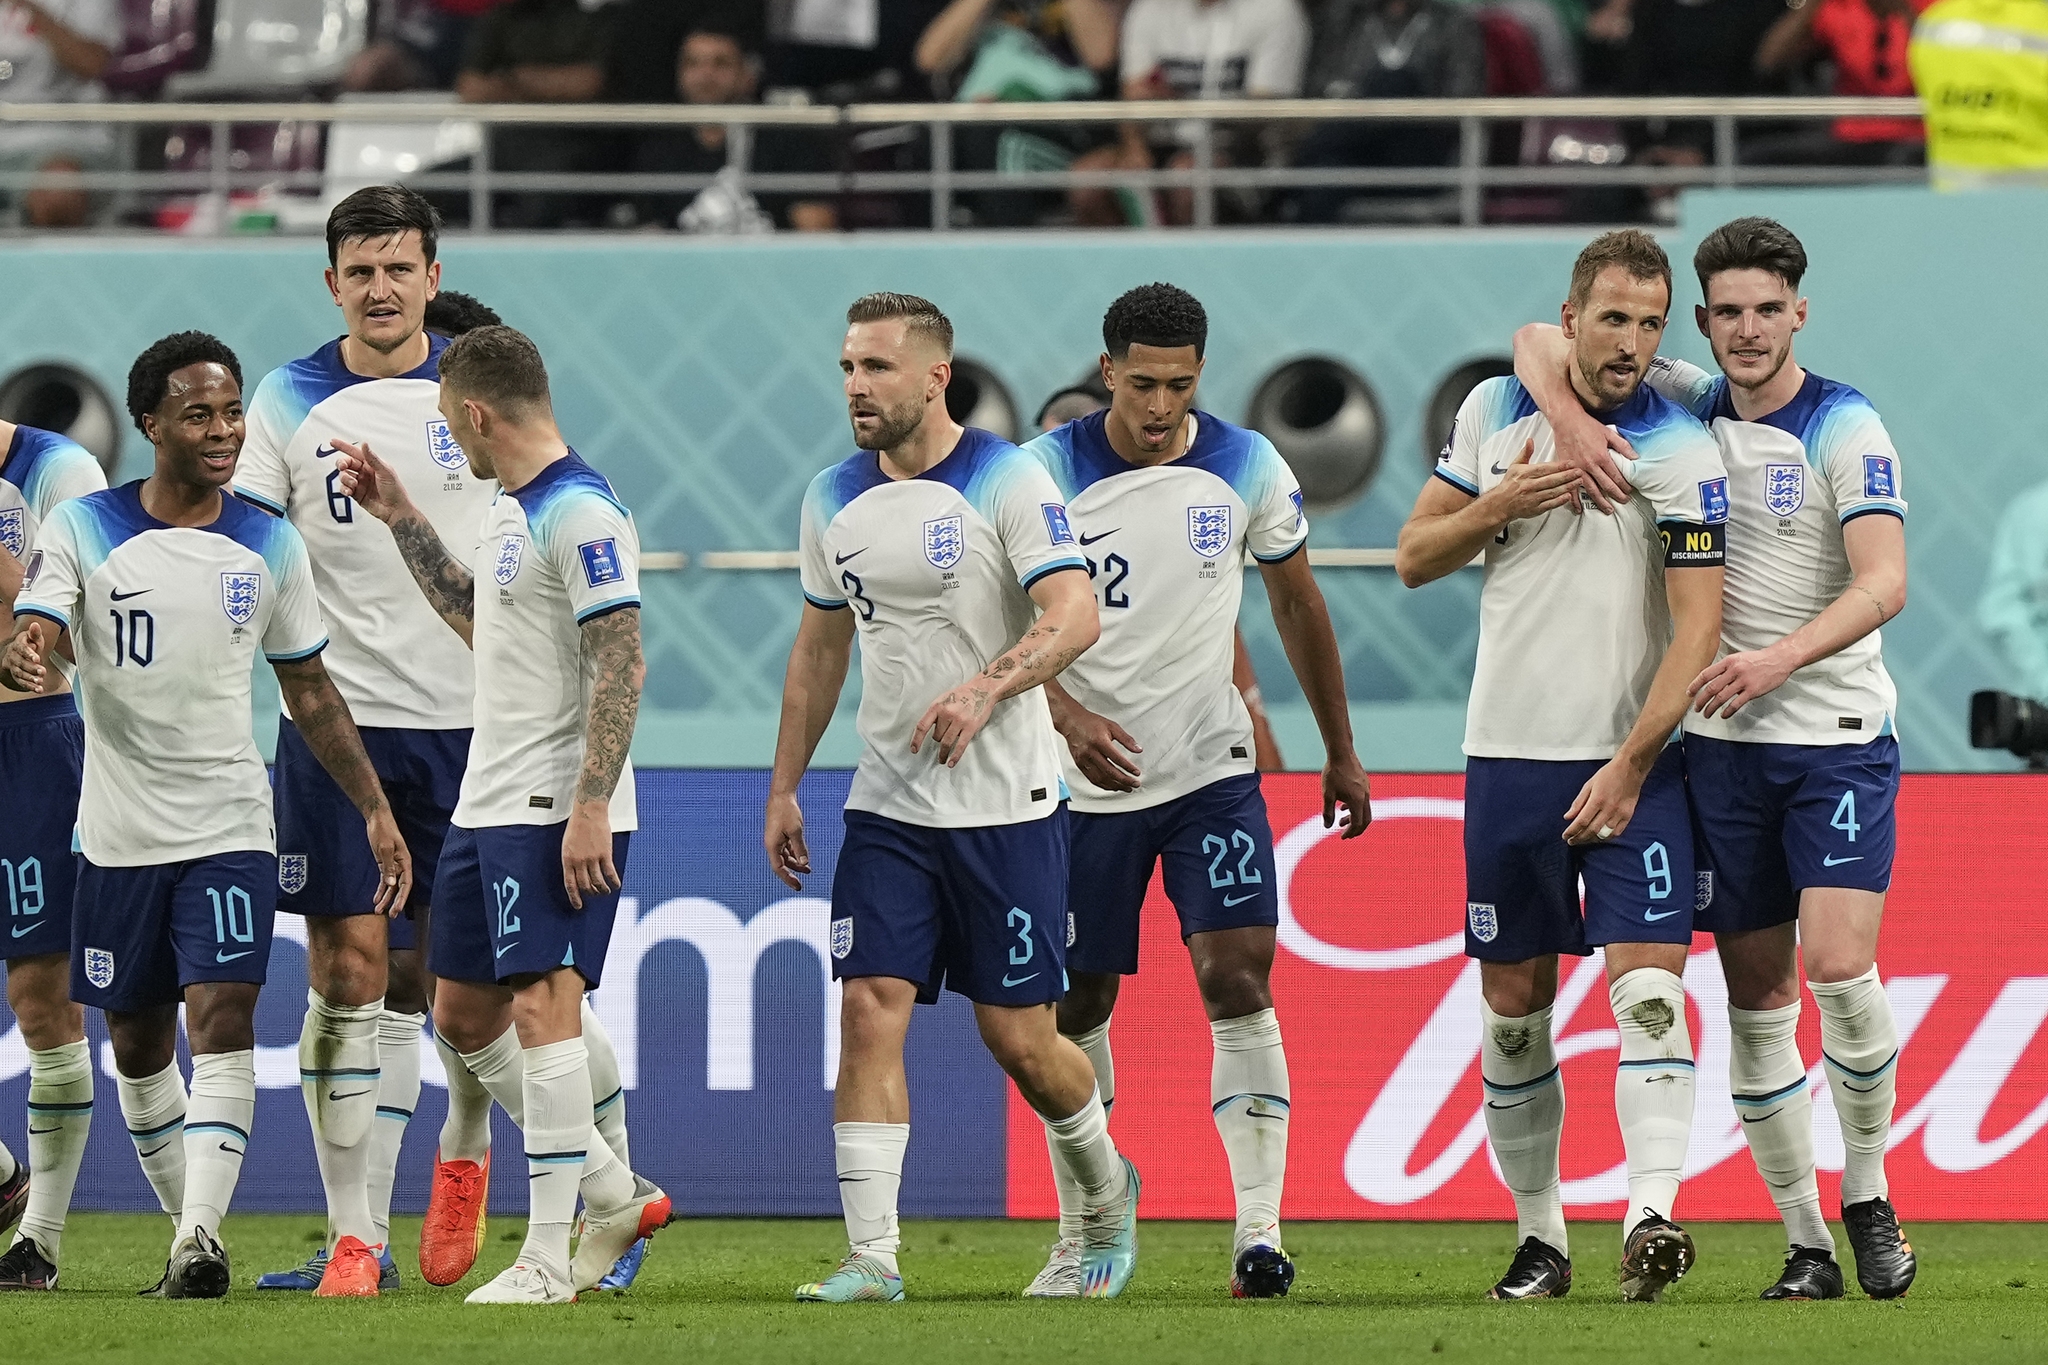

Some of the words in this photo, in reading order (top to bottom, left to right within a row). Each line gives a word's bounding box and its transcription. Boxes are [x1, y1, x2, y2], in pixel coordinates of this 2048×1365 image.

[326, 467, 353, 523] 6
[1671, 551, 1723, 560] DISCRIMINATION
[1686, 531, 1712, 551] NO
[841, 569, 875, 620] 3
[110, 609, 154, 667] 10
[1830, 790, 1861, 842] 4
[1, 856, 45, 916] 19
[1202, 829, 1262, 889] 22
[1642, 841, 1673, 899] 9
[206, 885, 254, 943] 10
[493, 876, 520, 938] 12
[1007, 906, 1034, 965] 3
